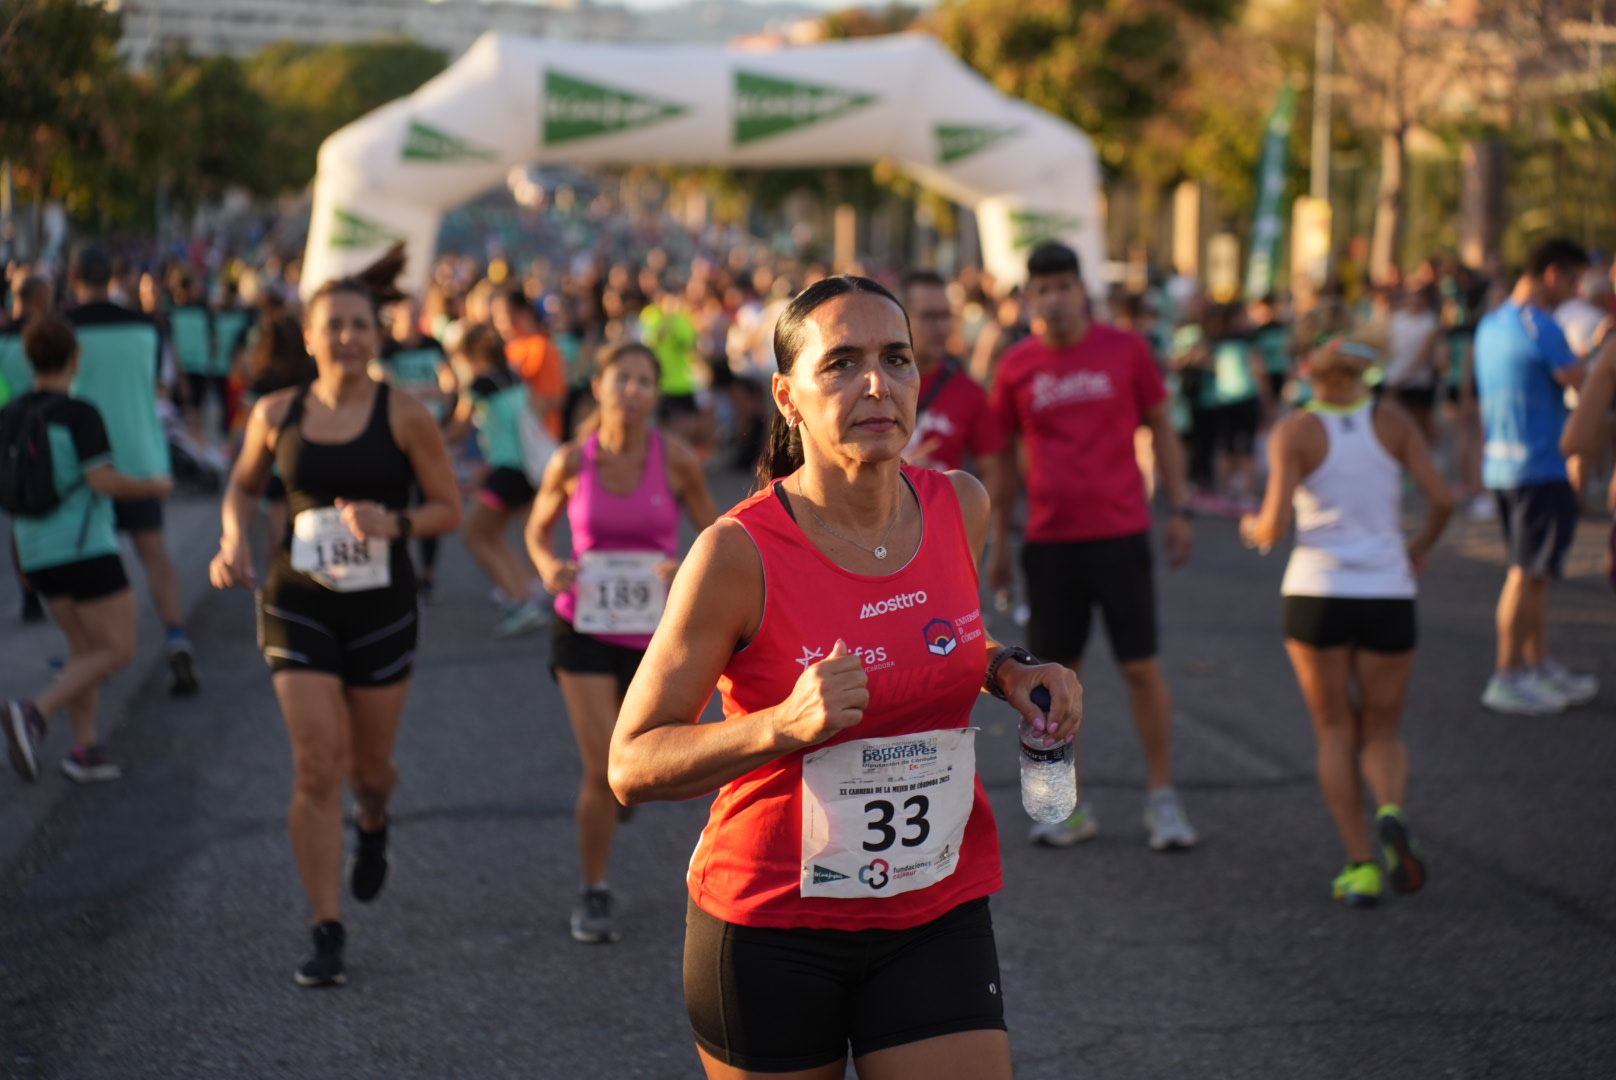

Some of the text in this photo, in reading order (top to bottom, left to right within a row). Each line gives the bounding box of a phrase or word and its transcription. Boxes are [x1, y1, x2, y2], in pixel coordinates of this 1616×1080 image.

[316, 540, 370, 571] 188
[598, 578, 650, 611] 189
[862, 743, 928, 757] carreras
[862, 746, 938, 763] populares
[840, 788, 848, 796] XX
[862, 795, 930, 852] 33
